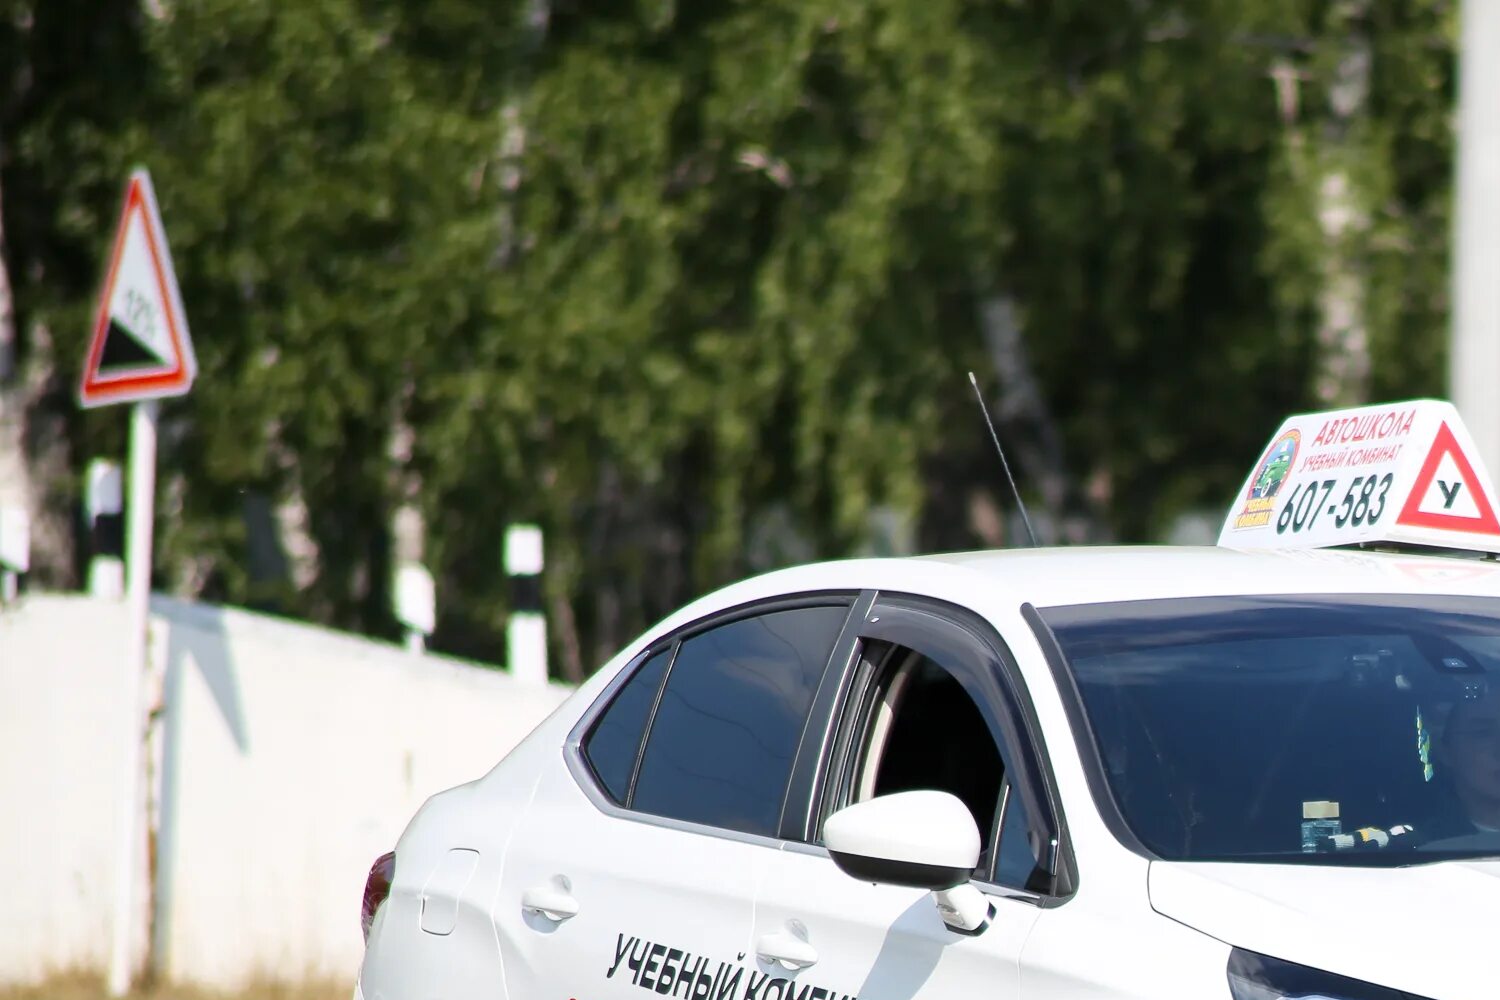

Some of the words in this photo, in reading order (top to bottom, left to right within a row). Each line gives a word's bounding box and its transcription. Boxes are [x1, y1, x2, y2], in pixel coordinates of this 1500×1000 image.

[1311, 408, 1417, 448] АВТОШКОЛА
[1299, 446, 1348, 473] УЧЕБНЫЙ
[1346, 443, 1403, 467] КОМБИНАТ
[1276, 472, 1394, 535] 607-583
[1437, 480, 1463, 510] У
